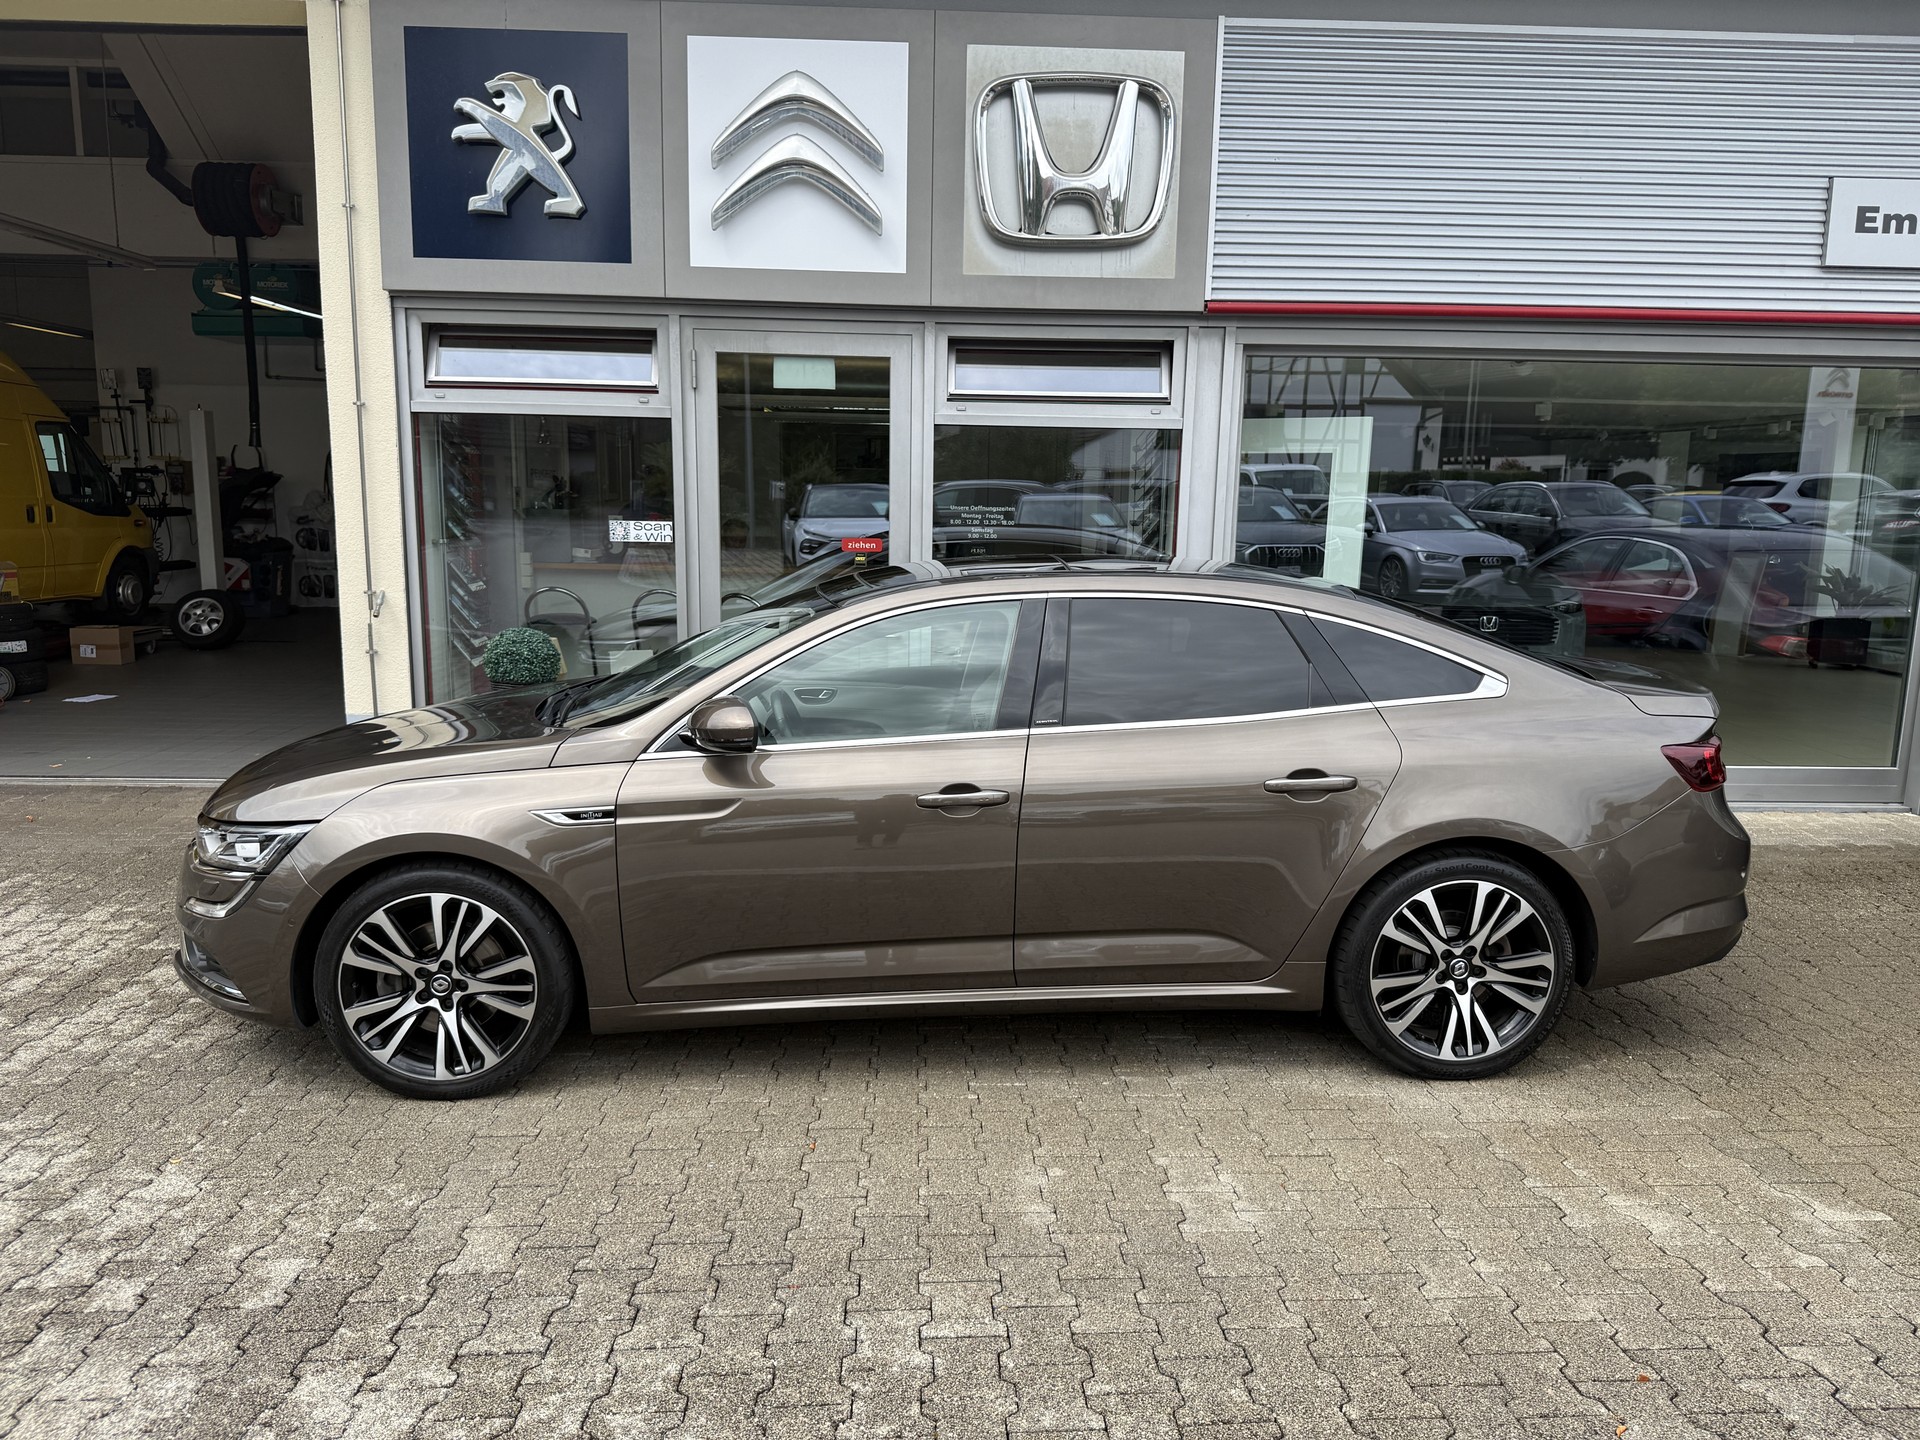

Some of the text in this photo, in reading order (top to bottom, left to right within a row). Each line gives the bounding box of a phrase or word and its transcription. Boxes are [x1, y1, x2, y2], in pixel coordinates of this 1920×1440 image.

[1855, 205, 1918, 235] Em
[633, 521, 673, 532] Scan
[633, 532, 673, 542] & Win
[847, 541, 876, 549] ziehen
[1434, 862, 1505, 875] SportContact
[1554, 978, 1572, 1015] 245/40
